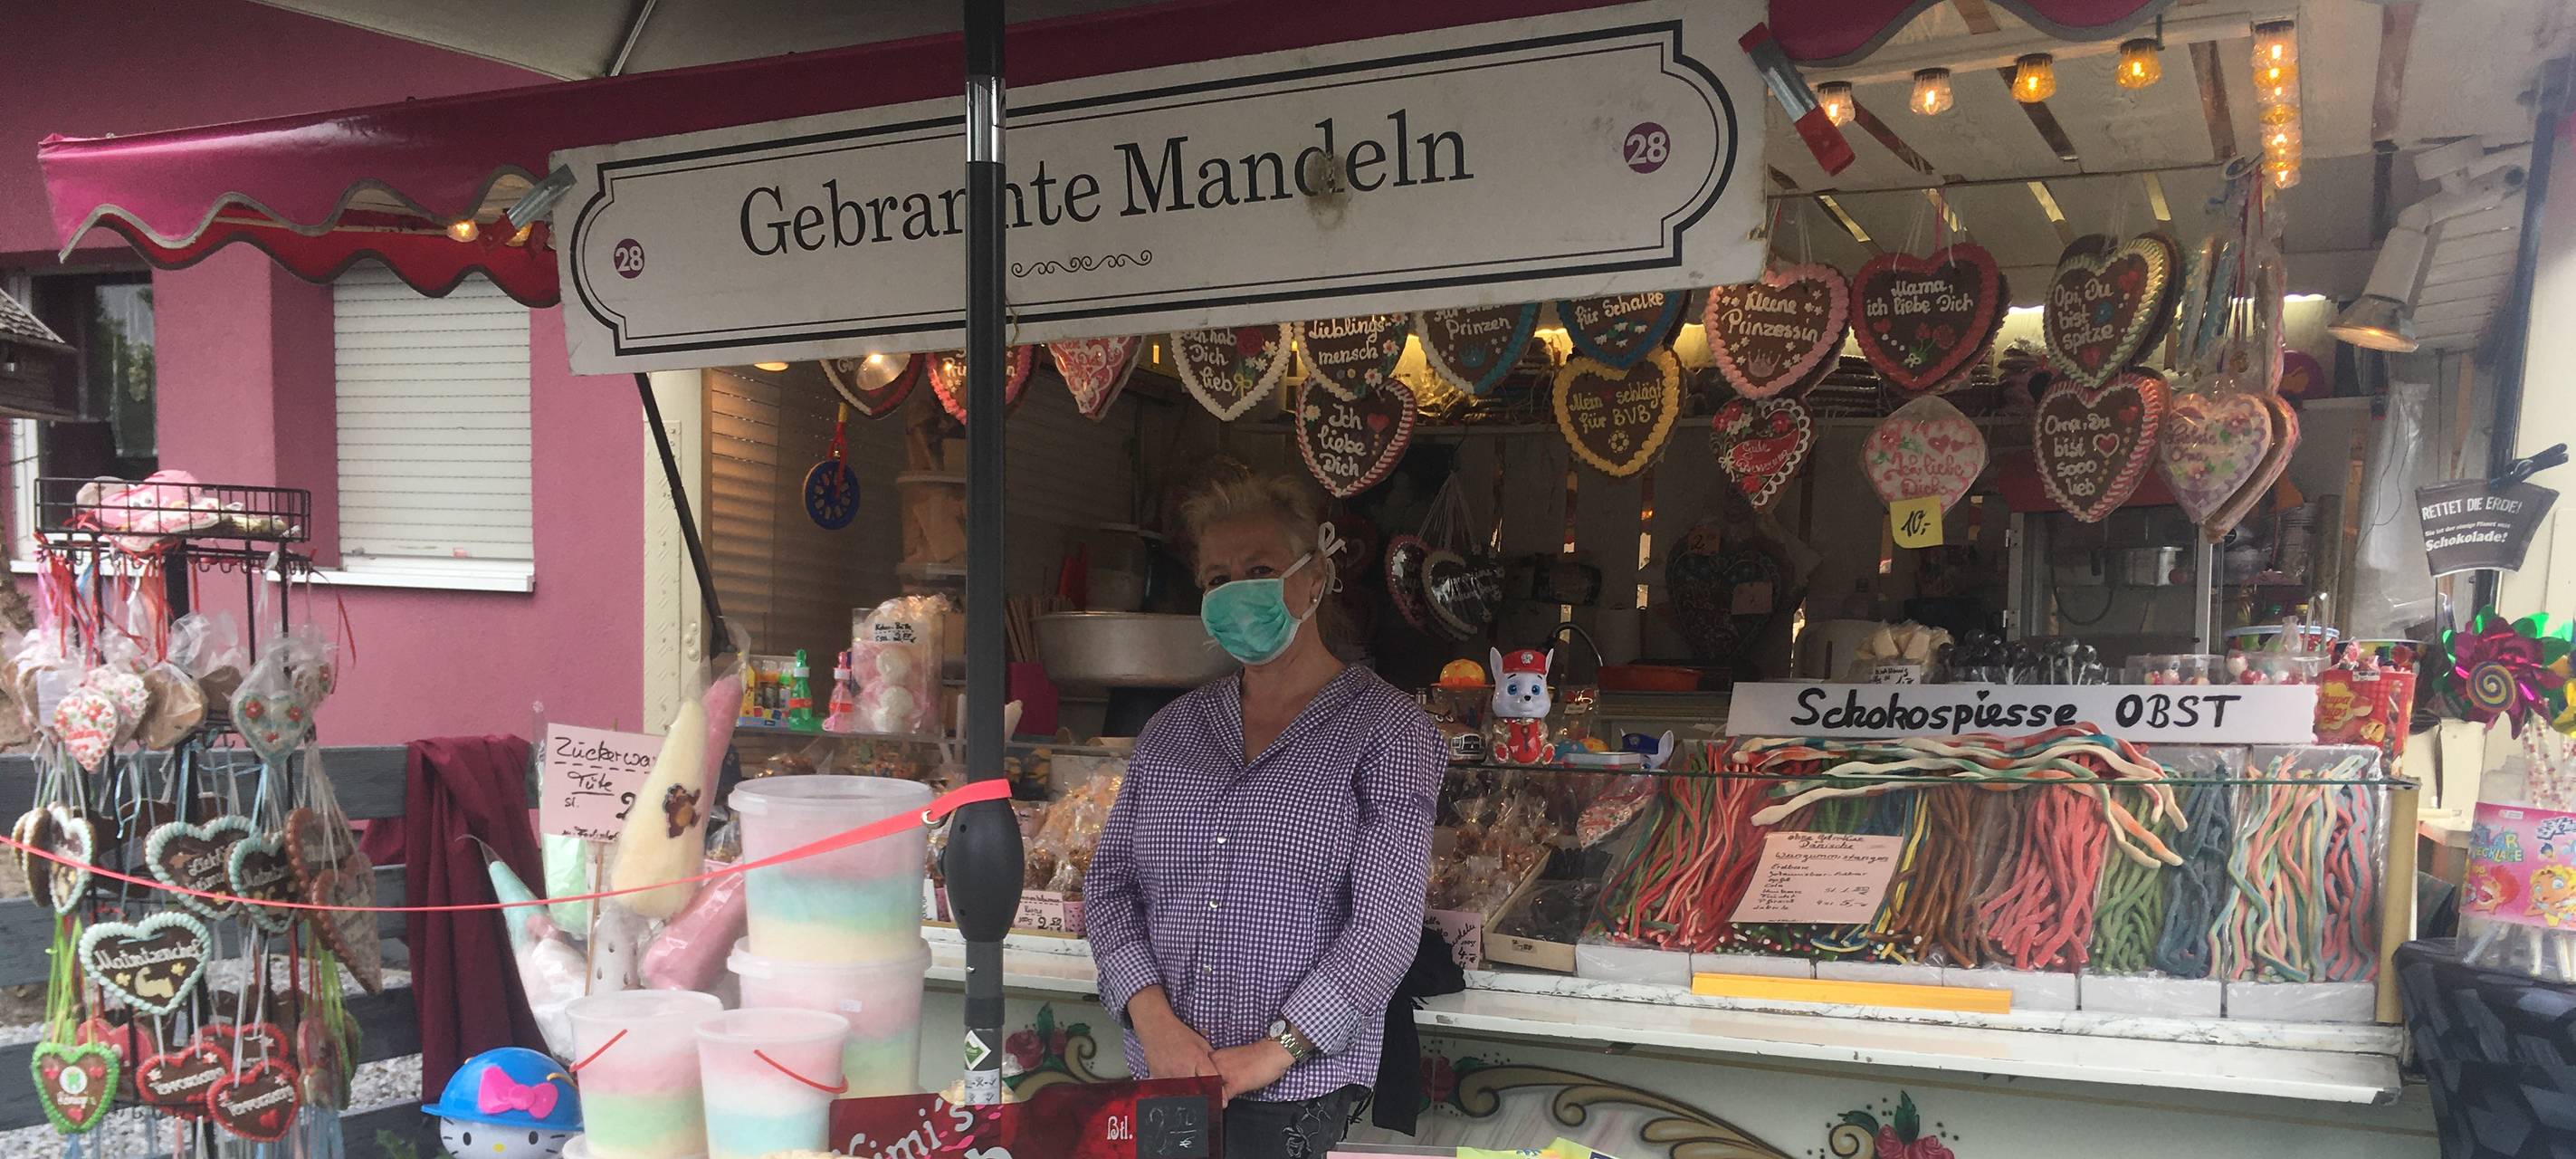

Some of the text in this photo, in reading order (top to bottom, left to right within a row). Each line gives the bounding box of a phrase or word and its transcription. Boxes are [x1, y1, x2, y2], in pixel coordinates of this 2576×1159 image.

[1627, 131, 1668, 166] 28
[1113, 108, 1474, 217] Mandeln
[614, 246, 644, 273] 28
[2085, 277, 2114, 301] Du
[1575, 291, 1666, 330] für Schalke
[1866, 292, 1974, 317] ich liebe Dich
[2057, 303, 2092, 330] bist
[1209, 327, 1237, 347] hab
[1445, 316, 1512, 341] Prinzen
[1721, 308, 1819, 343] Prinzessin
[2062, 322, 2115, 356] spitze
[1189, 344, 1229, 365] Dich
[1318, 344, 1379, 366] mensch
[1199, 366, 1233, 392] lieb
[1615, 378, 1665, 410] schlägt
[1328, 403, 1364, 431] Ich
[1579, 404, 1652, 435] für BVB
[2087, 412, 2111, 430] Du
[1317, 425, 1367, 457] liebe
[1741, 440, 1771, 453] Gute
[2053, 436, 2085, 458] bist
[1319, 452, 1360, 477] Dich
[1924, 454, 1963, 477] liebe
[2056, 459, 2098, 478] sooo
[2065, 475, 2096, 498] lieb
[2421, 496, 2524, 521] RETTET DIE ERDE!
[2425, 531, 2508, 551] Schokolade!
[1789, 688, 2242, 735] Schokospiesse OBST
[1106, 1115, 1133, 1141] Btl.
